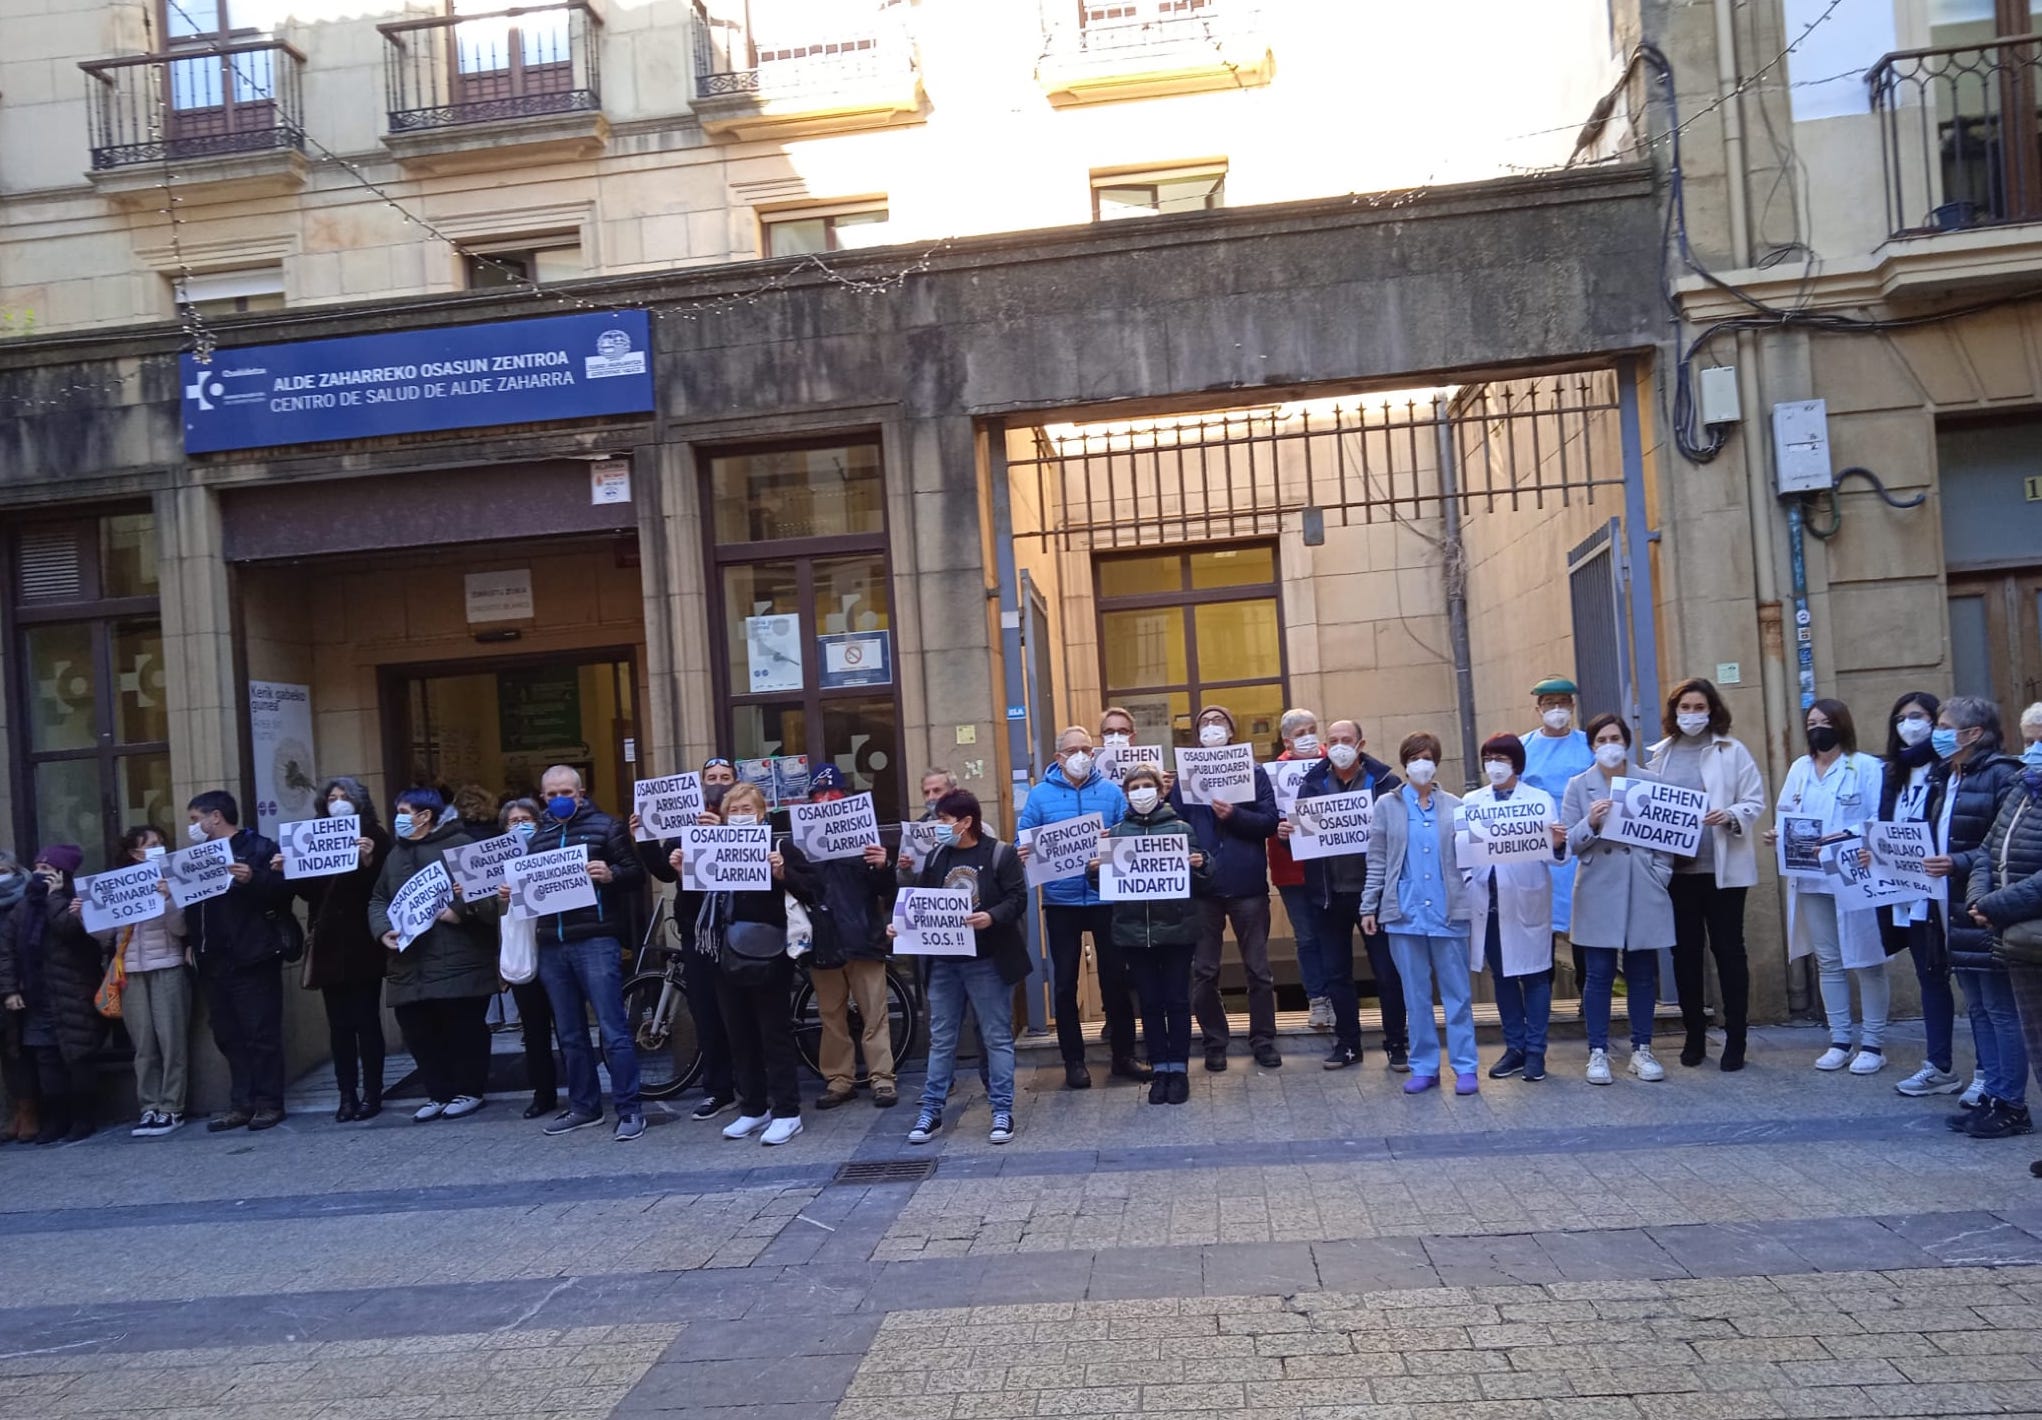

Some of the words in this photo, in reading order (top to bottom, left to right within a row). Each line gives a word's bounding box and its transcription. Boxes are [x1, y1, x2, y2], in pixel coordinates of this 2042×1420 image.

[273, 374, 317, 392] ALDE
[319, 365, 418, 388] ZAHARREKO
[420, 357, 489, 378] OSASUN
[492, 350, 570, 371] ZENTROA
[270, 393, 336, 413] CENTRO
[339, 390, 363, 407] DE
[365, 385, 420, 405] SALUD
[424, 382, 448, 399] DE
[450, 377, 494, 396] ALDE
[497, 370, 576, 392] ZAHARRA
[1115, 748, 1160, 763] LEHEN
[1184, 747, 1249, 762] OSASUNGINTZA
[1193, 761, 1250, 775] PUBLIKOAREN
[636, 775, 697, 797] OSAKIDETZA
[1201, 774, 1251, 789] DEFENTSAN
[656, 793, 699, 813] ARRISKU
[1295, 796, 1368, 816] KALITATEZKO
[1651, 784, 1704, 810] LEHEN
[798, 797, 870, 820] OSAKIDETZA
[1465, 802, 1546, 822] KALITATEZKO
[1639, 804, 1699, 830] ARRETA
[312, 818, 356, 834] LEHEN
[824, 814, 872, 836] ARRISKU
[1039, 819, 1101, 846] ATENCION
[1490, 820, 1543, 837] OSASUN
[1885, 826, 1922, 841] LEHEN
[479, 834, 518, 854] LEHEN
[690, 829, 767, 843] OSAKIDETZA
[826, 831, 876, 852] LARRIAN
[1621, 820, 1696, 850] INDARTU
[188, 842, 224, 860] LEHEN
[308, 836, 357, 853] ARRETA
[1134, 837, 1184, 853] LEHEN
[1488, 837, 1548, 855] PUBLIKOA
[298, 853, 356, 872] INDARTU
[470, 847, 523, 870] MAILAKO
[514, 849, 583, 872] OSASUNGINTZA
[715, 848, 767, 862] ARRISKU
[182, 855, 227, 874] MAILAKO
[526, 862, 585, 884] PUBLIKOAREN
[1129, 857, 1186, 873] ARRETA
[1894, 862, 1925, 874] ARRET
[94, 867, 159, 893] ATENCION
[198, 866, 228, 882] ARRET
[715, 867, 767, 882] LARRIAN
[391, 865, 443, 914] OSAKIDETZA
[469, 884, 498, 897] NIK
[538, 875, 588, 894] DEFENTSAN
[1117, 877, 1185, 894] INDARTU
[1879, 879, 1910, 889] NIK
[101, 884, 160, 906] PRIMARIA
[184, 888, 212, 901] NIK
[408, 880, 449, 913] ARRISKU
[112, 904, 147, 920] S.O.S.
[909, 896, 969, 912] ATENCION
[914, 915, 967, 929] PRIMARIA
[922, 932, 954, 945] S.O.S.
